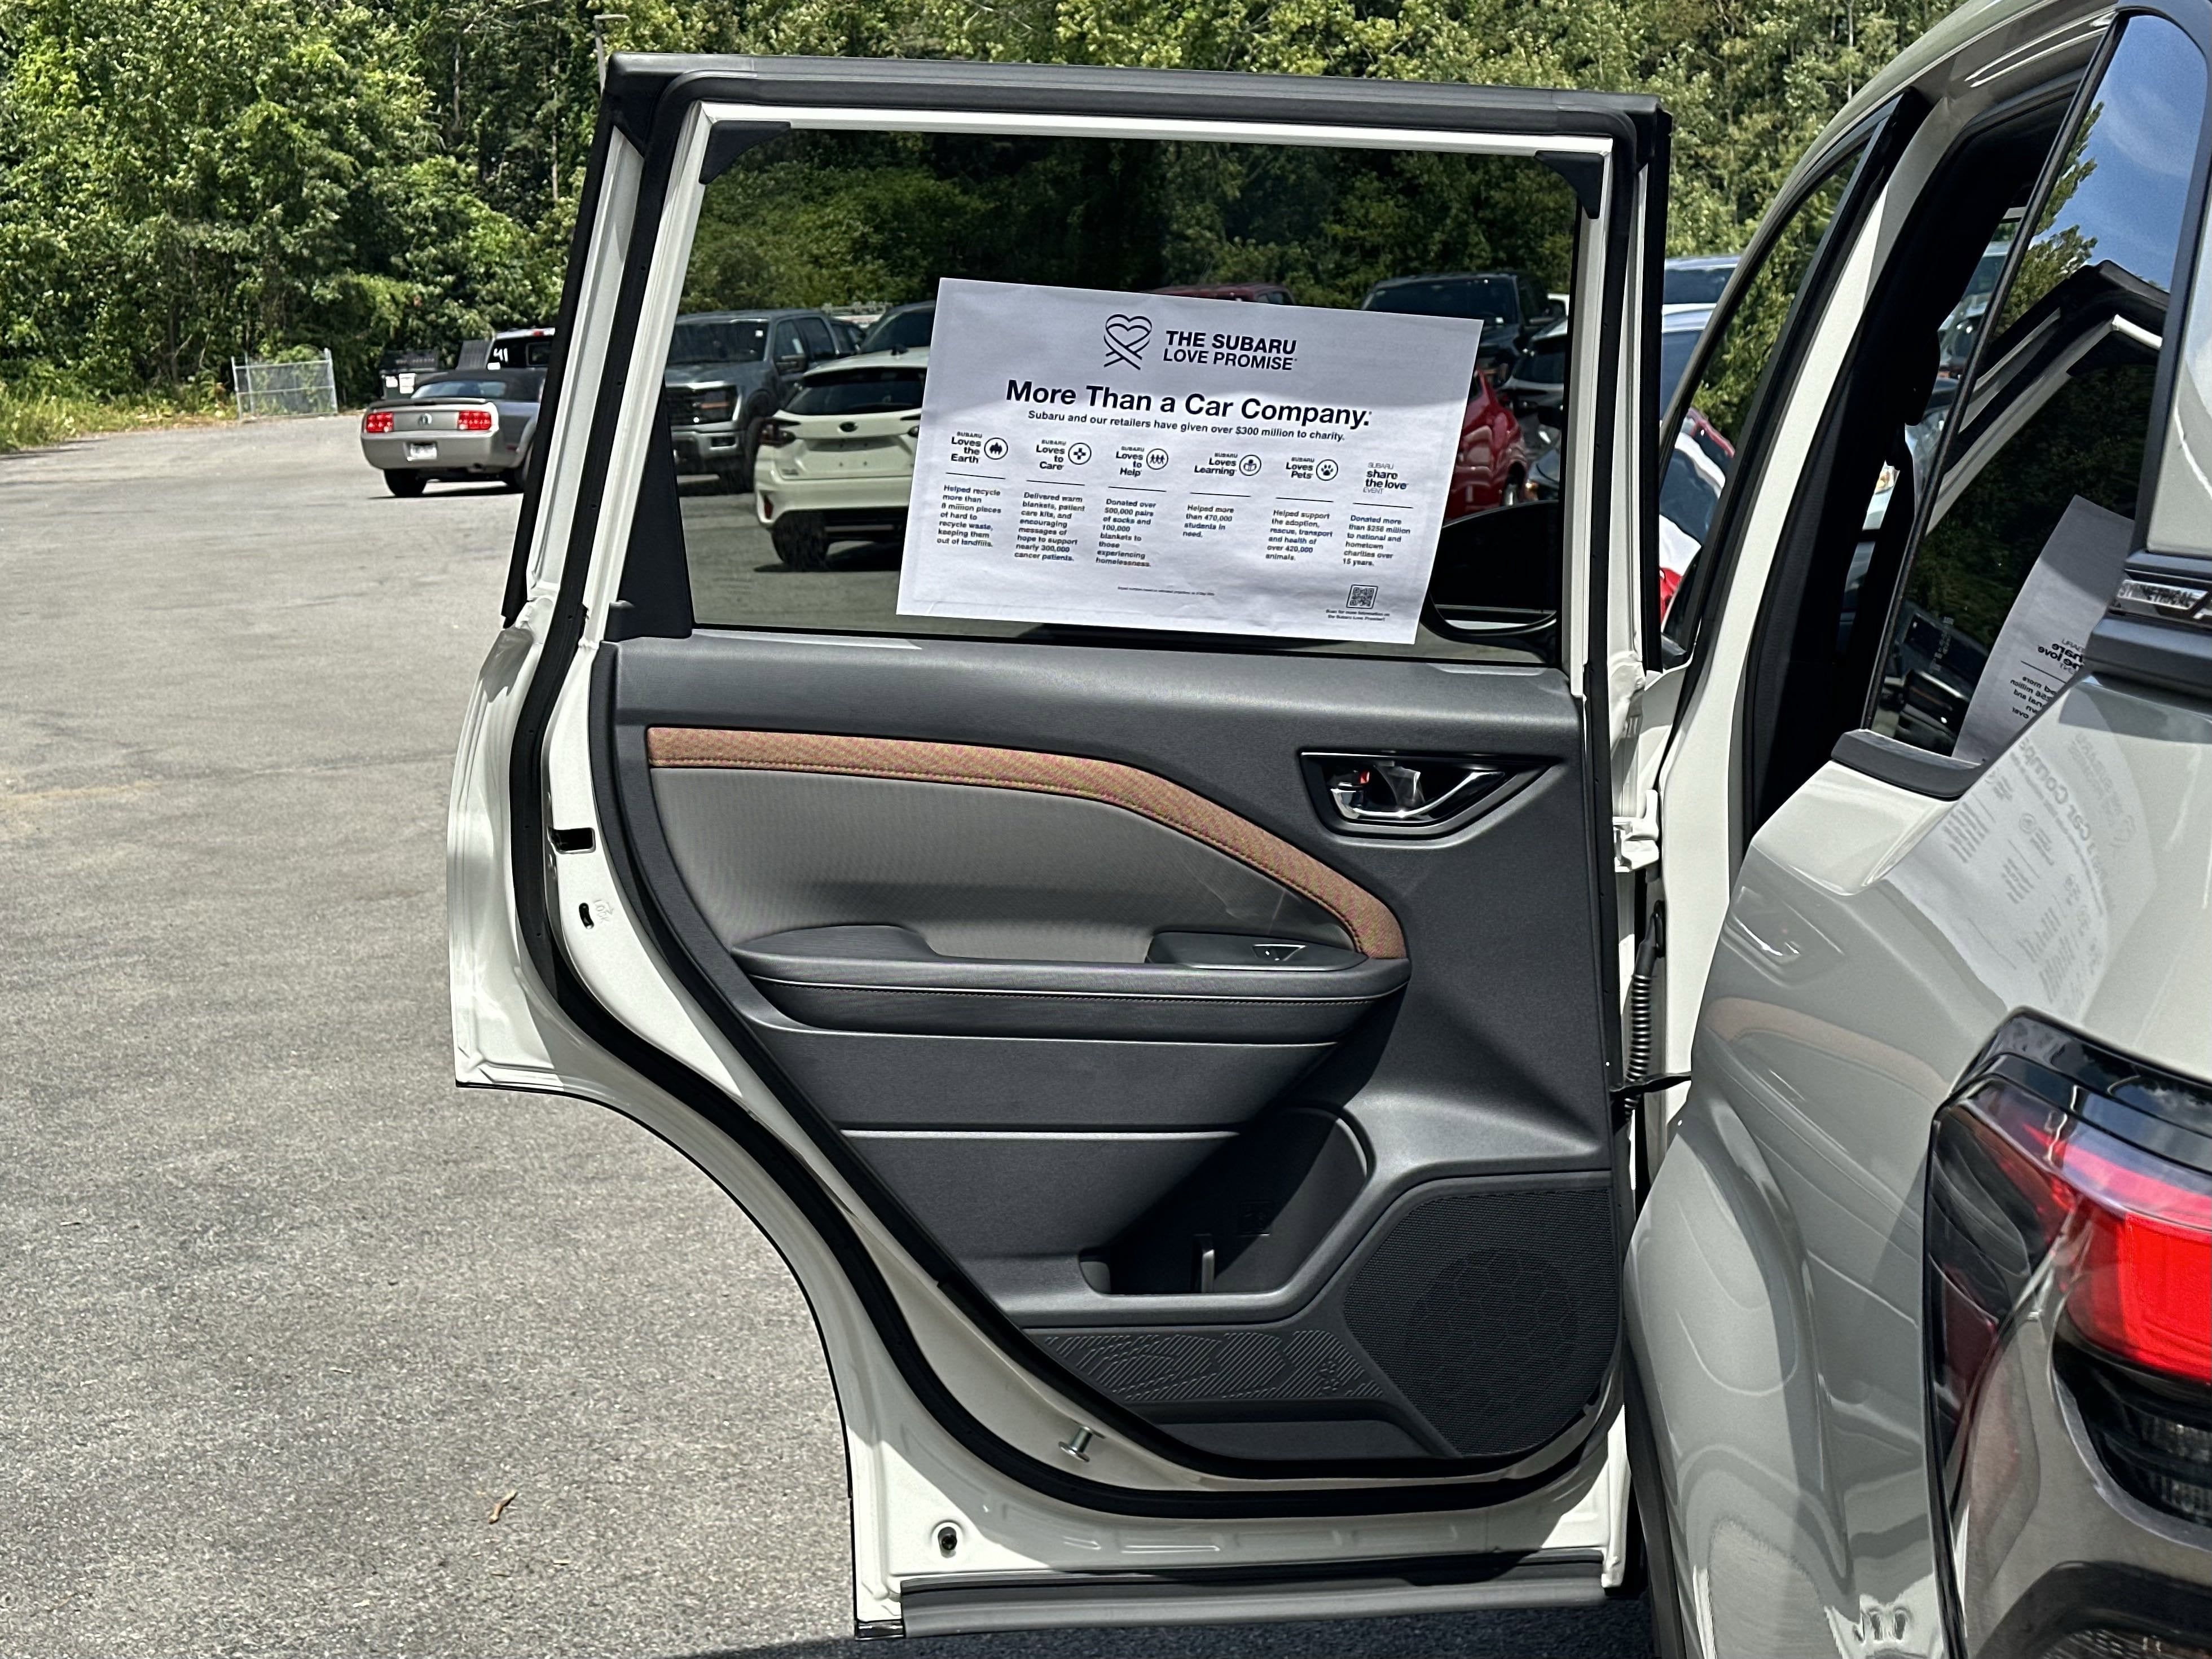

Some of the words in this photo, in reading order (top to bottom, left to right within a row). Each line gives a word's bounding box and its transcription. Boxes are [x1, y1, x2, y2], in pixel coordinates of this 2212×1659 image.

[1166, 330, 1207, 348] THE
[1211, 333, 1297, 355] SUBARU
[1163, 347, 1210, 364] LOVE
[1006, 379, 1076, 405] More
[1085, 385, 1152, 411] Than
[1160, 397, 1176, 413] a
[1185, 393, 1234, 417] Car
[1027, 410, 1066, 421] Subaru
[1067, 413, 1088, 423] and
[1089, 416, 1109, 425] our
[1110, 417, 1151, 428] retailers
[1153, 419, 1178, 430] have
[1180, 421, 1209, 433] given
[1211, 426, 1234, 434] over
[1235, 425, 1259, 436] $300
[1261, 427, 1295, 438] million
[1296, 429, 1307, 438] to
[1309, 430, 1345, 443] charity.
[951, 436, 982, 447] Loves
[963, 446, 980, 456] the
[1036, 444, 1066, 455] Loves
[1053, 455, 1065, 463] to
[1115, 451, 1144, 461] Loves
[1132, 460, 1142, 469] to
[1208, 457, 1237, 467] Loves
[1285, 461, 1314, 472] Loves
[1366, 469, 1399, 480] share
[1364, 478, 1384, 489] the
[943, 484, 971, 494] Helped
[973, 488, 1001, 497] recycle
[964, 495, 982, 504] than
[1023, 491, 1061, 501] Delivered
[1105, 498, 1138, 507] Donated
[948, 503, 975, 512] million
[975, 505, 1002, 514] pieces
[1186, 504, 1215, 513] Helped
[949, 512, 968, 520] hard
[1272, 509, 1300, 518] Helped
[1300, 512, 1330, 521] support
[1350, 514, 1382, 524] Donated
[938, 521, 968, 529] recycle
[1019, 518, 1068, 529] encouraging
[1184, 522, 1217, 530] students
[938, 527, 969, 538] keeping
[1018, 527, 1057, 536] messages
[1298, 528, 1334, 538] transport
[1348, 523, 1366, 531] than
[1385, 526, 1411, 535] million
[1017, 534, 1037, 543] hope
[1047, 538, 1078, 546] support
[1100, 531, 1132, 541] blankets
[1284, 536, 1307, 544] health
[1356, 533, 1386, 542] national
[1015, 543, 1040, 552] nearly
[1098, 540, 1120, 549] those
[1096, 549, 1146, 560] experiencing
[1343, 549, 1375, 558] charities
